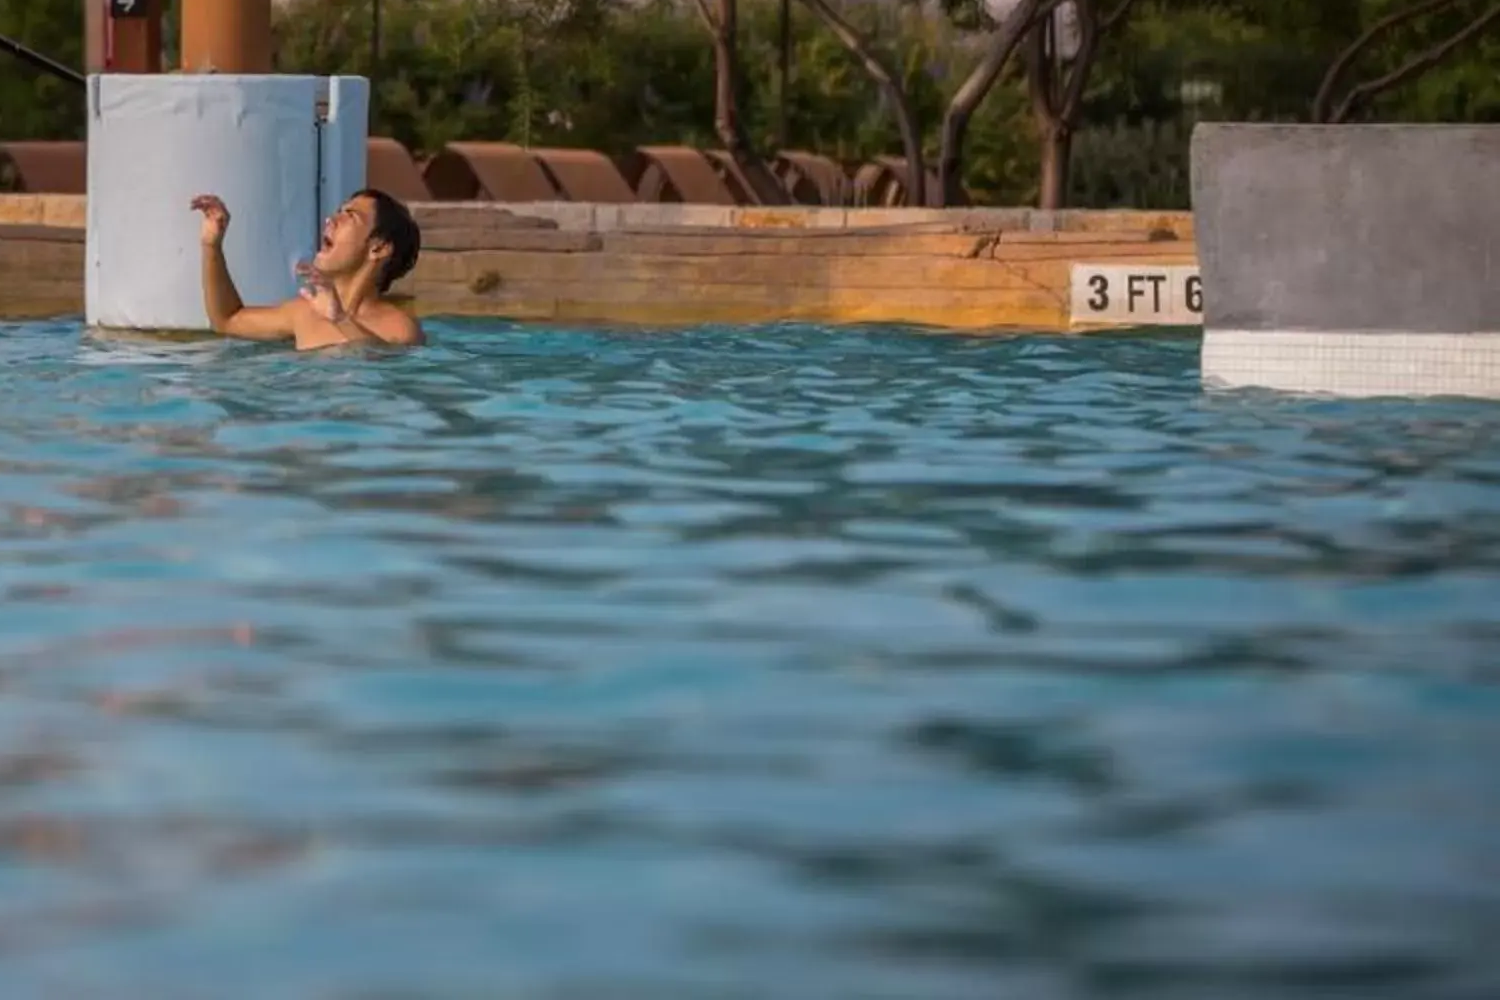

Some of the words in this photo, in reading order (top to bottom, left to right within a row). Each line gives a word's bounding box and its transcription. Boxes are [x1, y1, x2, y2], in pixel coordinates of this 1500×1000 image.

[1087, 275, 1109, 312] 3
[1127, 274, 1166, 312] FT
[1185, 275, 1203, 313] 6
